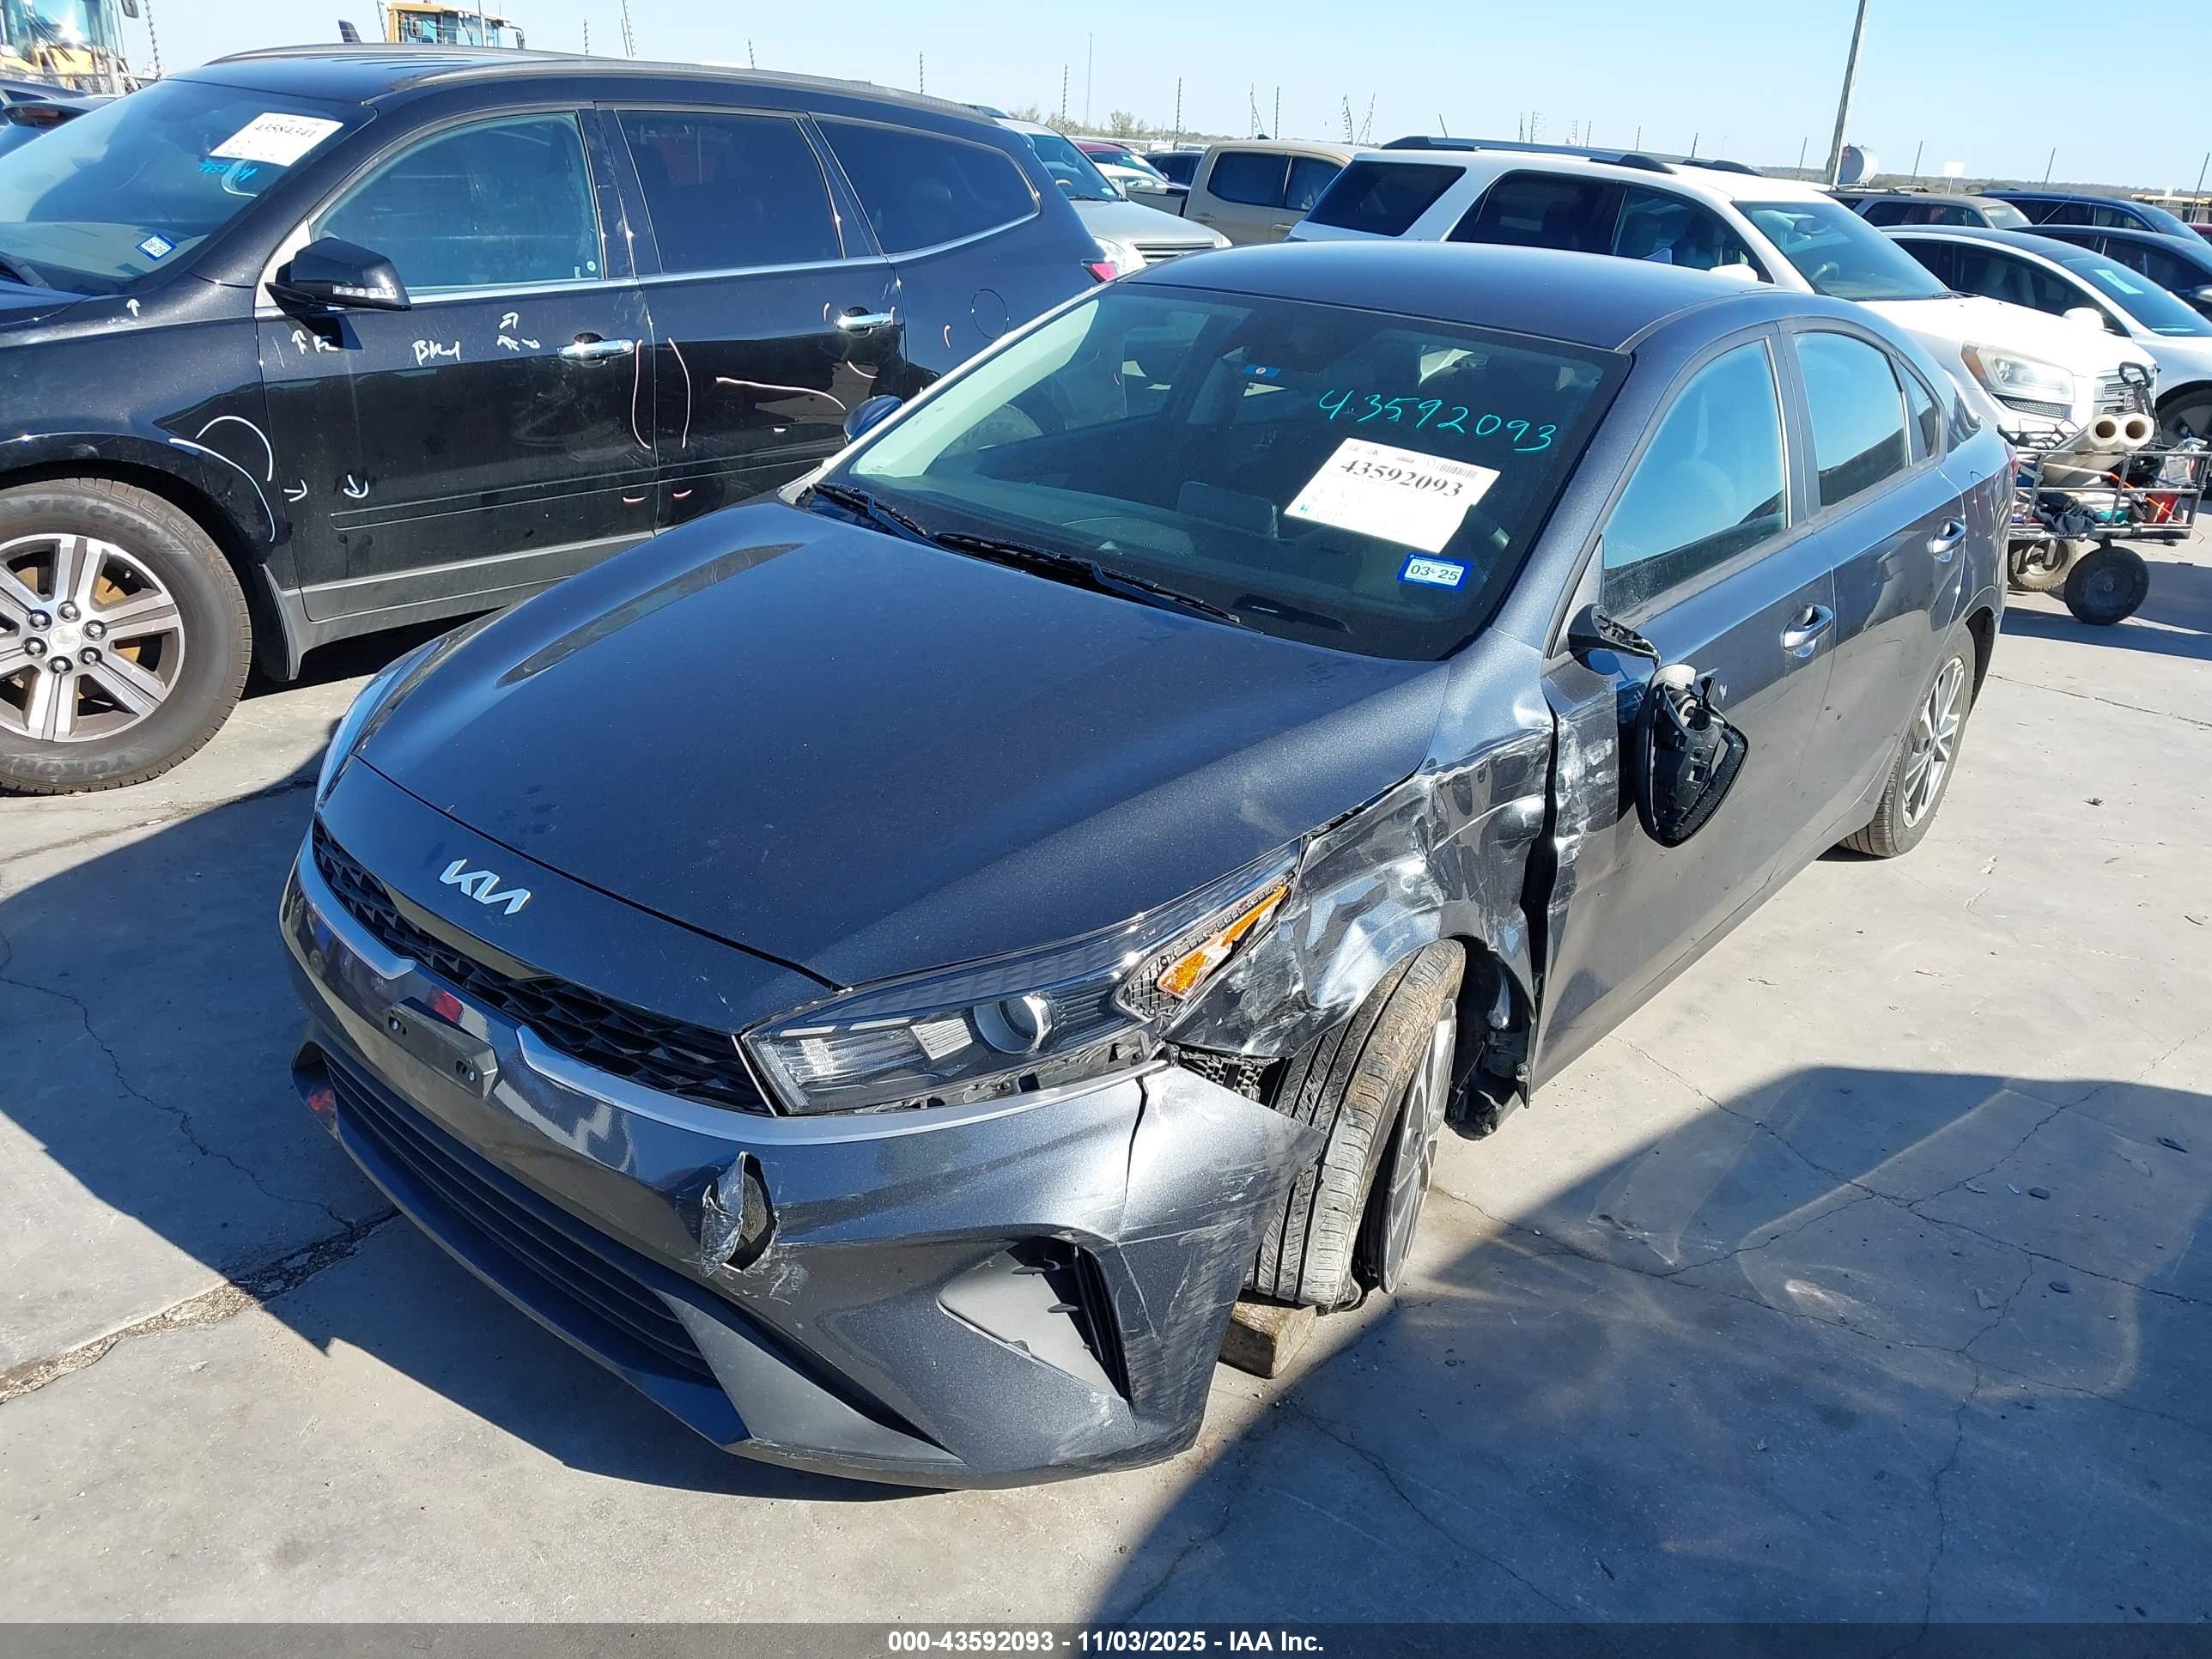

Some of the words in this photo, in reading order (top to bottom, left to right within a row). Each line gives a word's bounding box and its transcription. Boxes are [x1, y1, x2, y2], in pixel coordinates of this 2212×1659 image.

[1319, 390, 1557, 453] 43592093
[1340, 459, 1463, 497] 43592093
[439, 859, 532, 915] KIA
